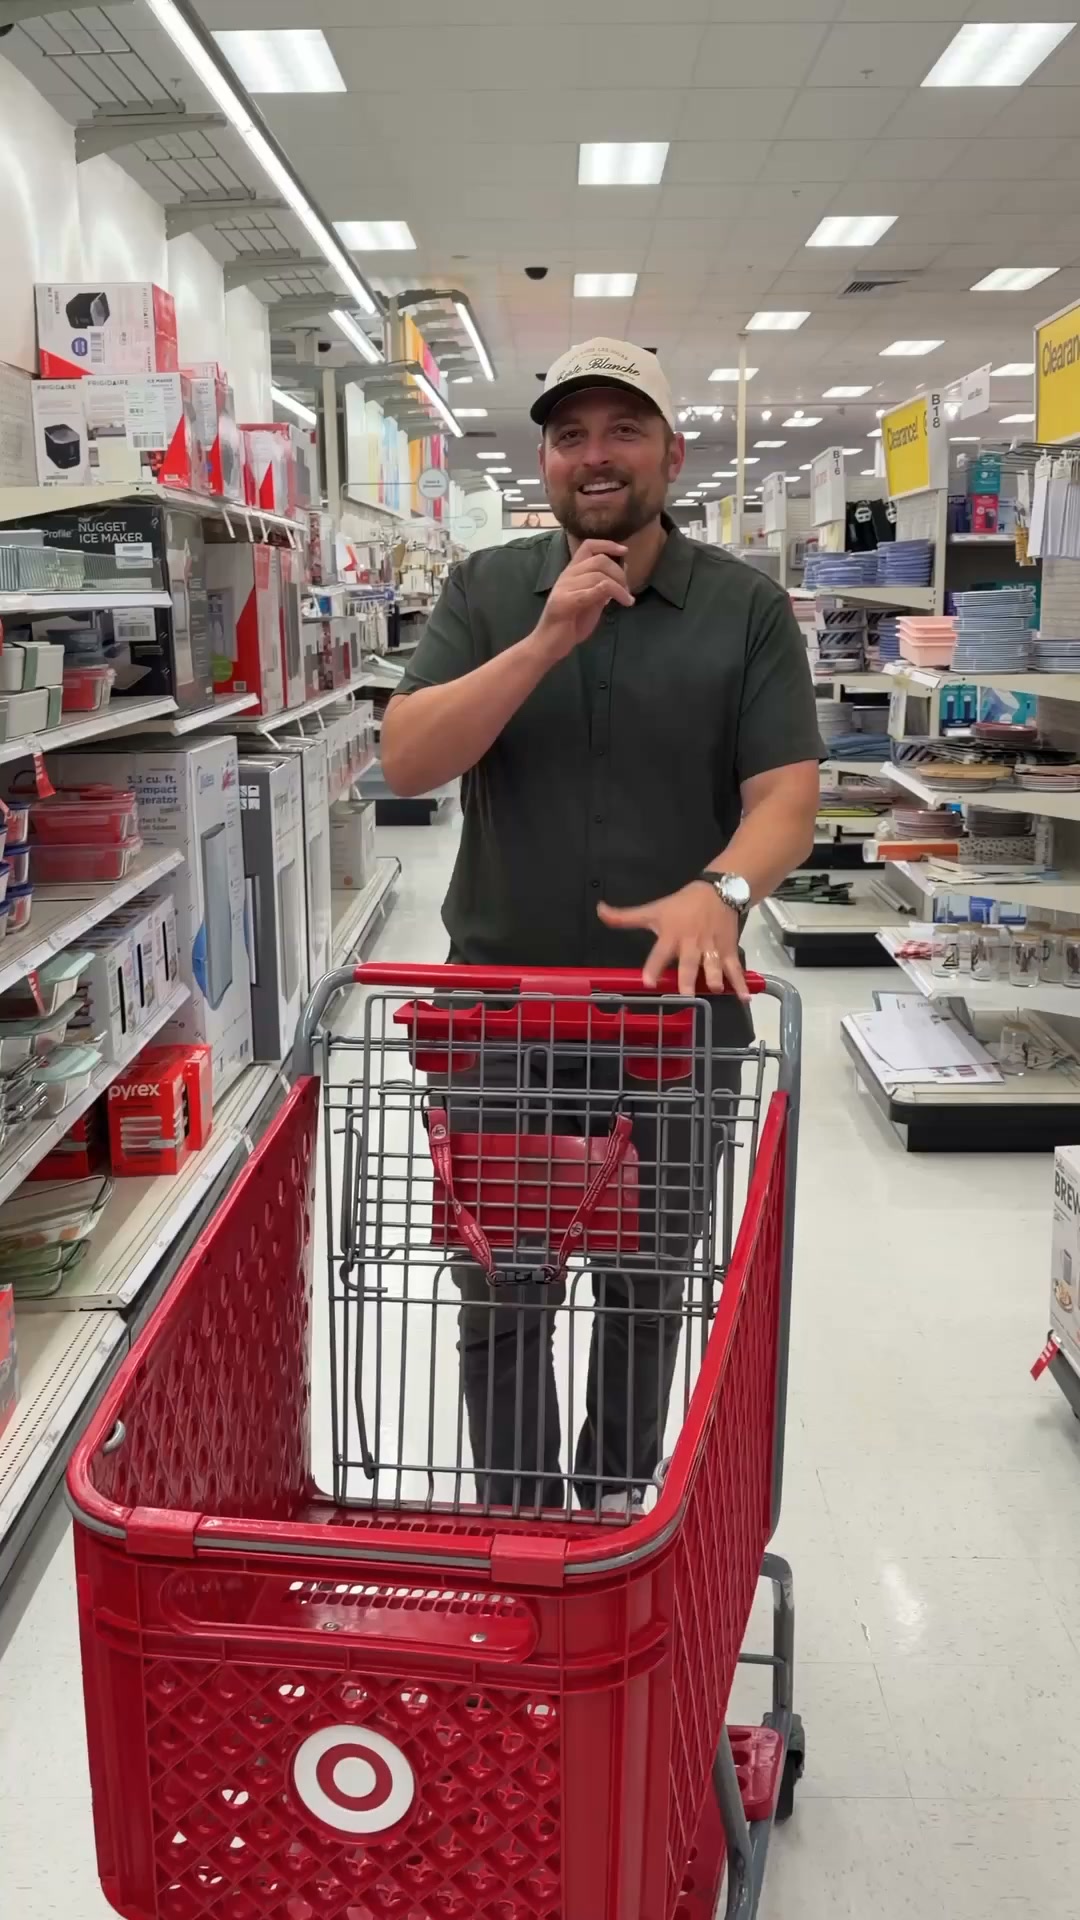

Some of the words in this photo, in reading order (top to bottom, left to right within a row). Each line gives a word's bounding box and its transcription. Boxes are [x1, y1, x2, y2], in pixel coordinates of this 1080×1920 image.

[931, 394, 941, 428] B18
[78, 521, 127, 532] NUGGET
[43, 529, 72, 538] Profile
[79, 533, 99, 544] ICE
[101, 532, 143, 543] MAKER
[145, 776, 160, 784] cu.
[165, 774, 176, 784] ft.
[108, 1083, 161, 1101] pyrex
